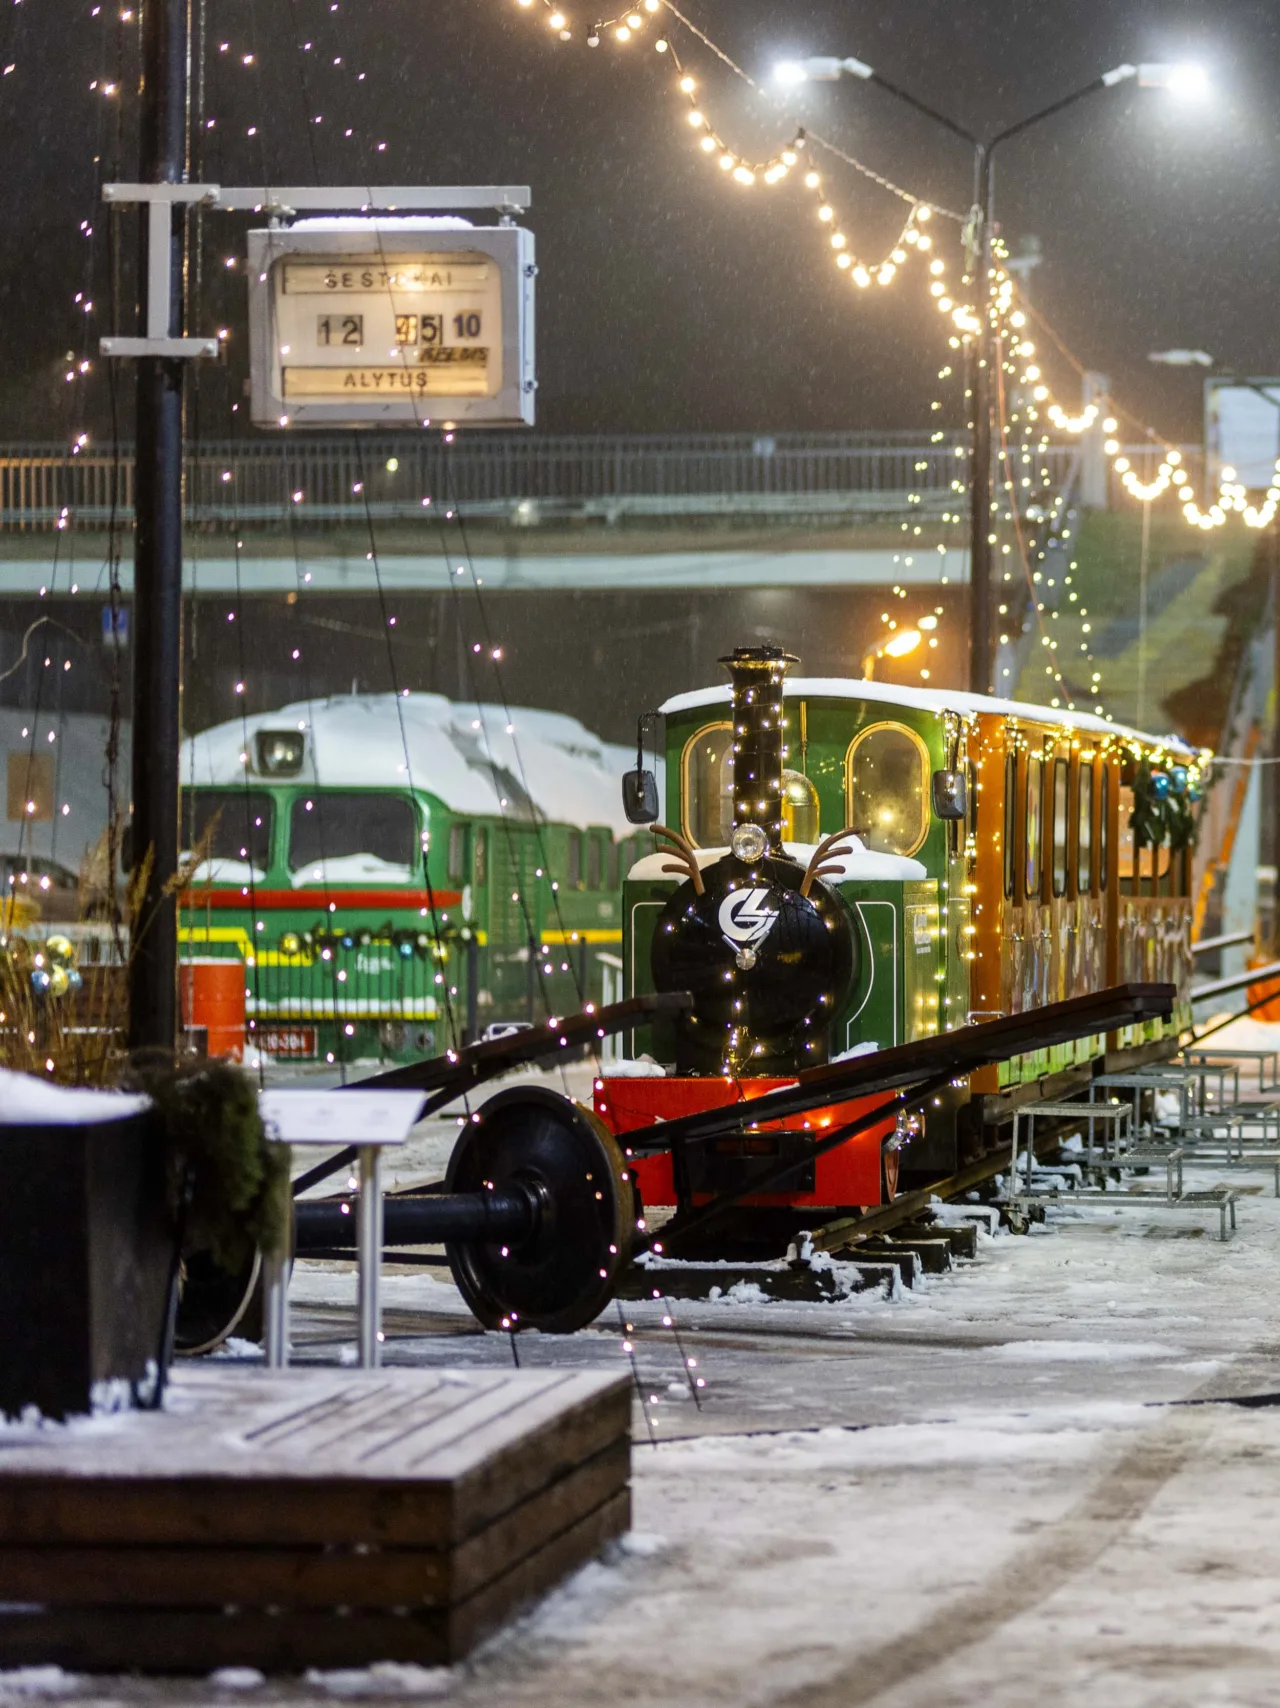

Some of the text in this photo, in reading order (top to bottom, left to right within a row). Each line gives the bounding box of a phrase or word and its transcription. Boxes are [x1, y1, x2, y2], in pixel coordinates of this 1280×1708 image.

[321, 319, 359, 344] 12
[453, 314, 481, 338] 10
[343, 372, 428, 387] ALYTUS
